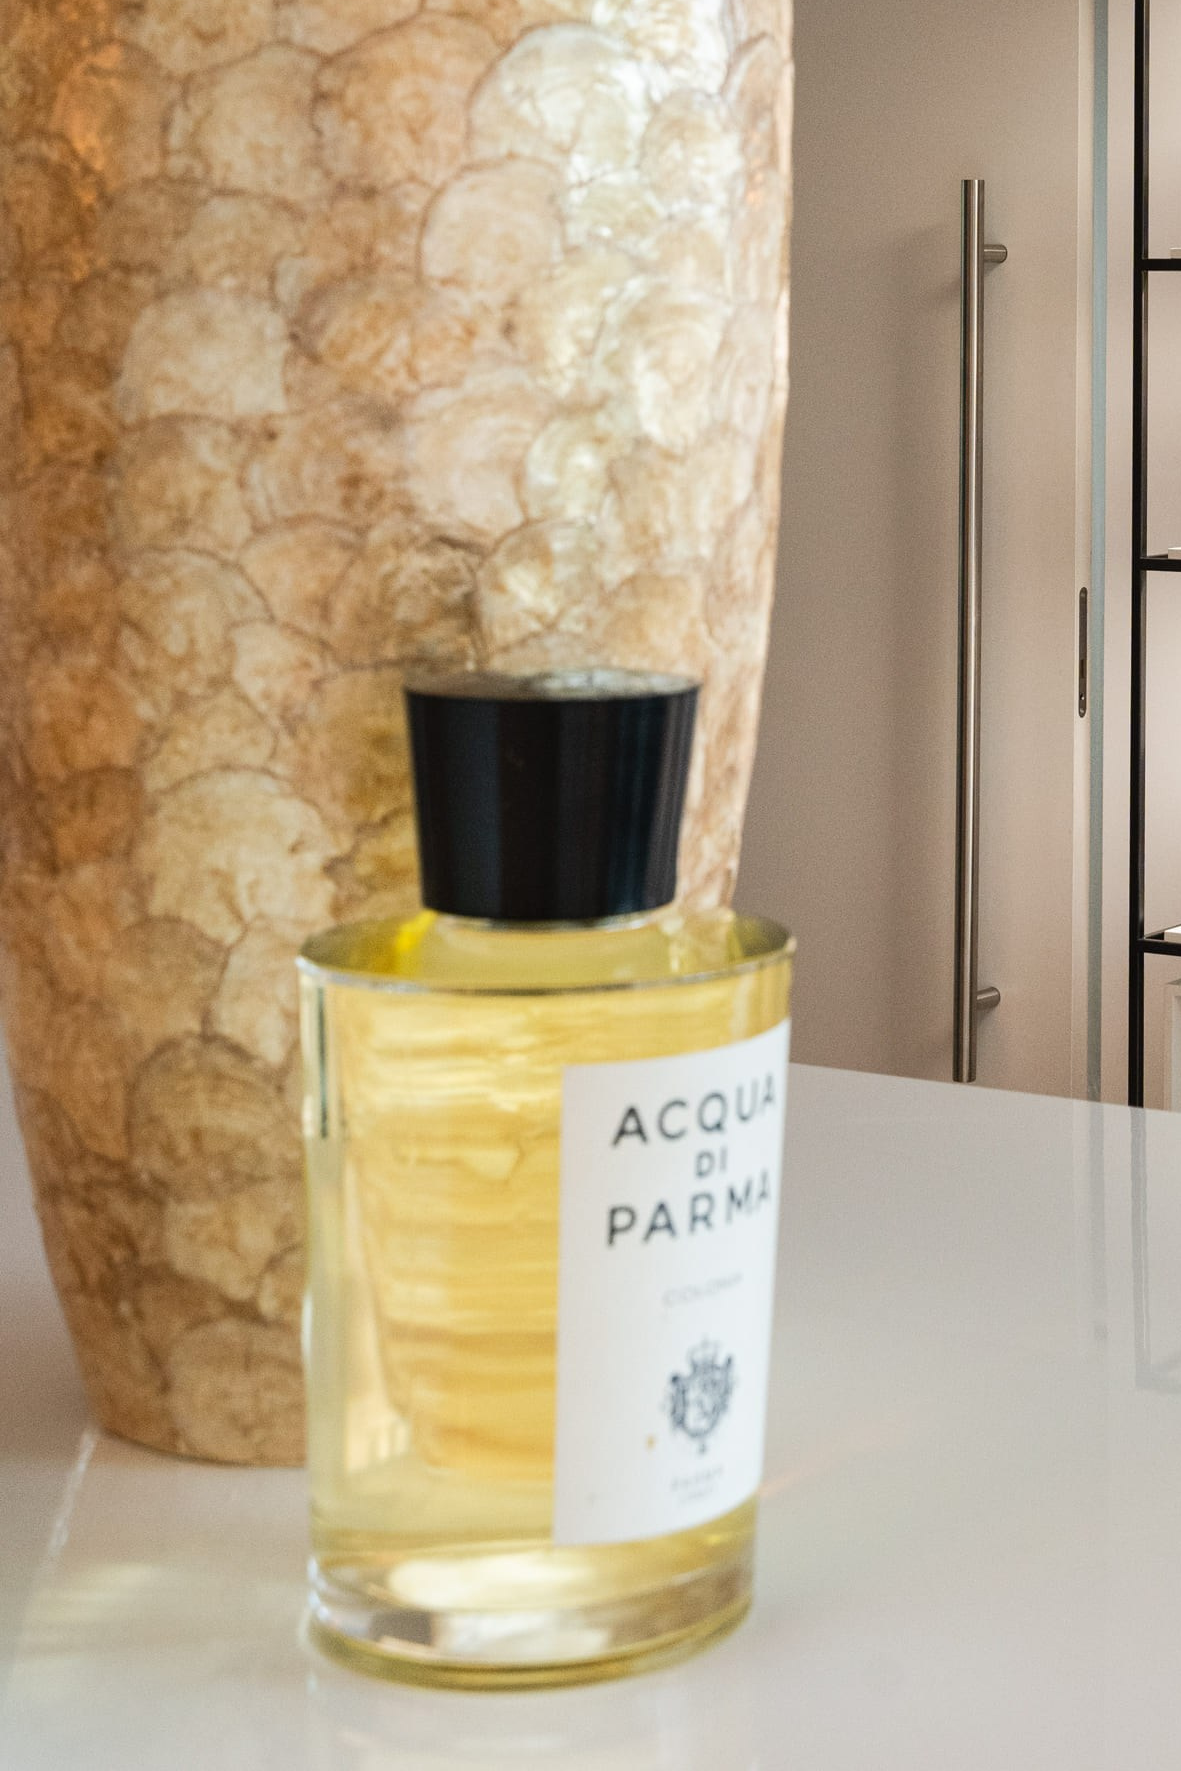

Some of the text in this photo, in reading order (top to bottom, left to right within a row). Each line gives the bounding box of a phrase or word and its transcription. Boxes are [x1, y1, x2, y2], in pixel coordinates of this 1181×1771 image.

[610, 1071, 776, 1149] ACQUA
[694, 1147, 728, 1180] DI
[606, 1167, 772, 1249] PARMA
